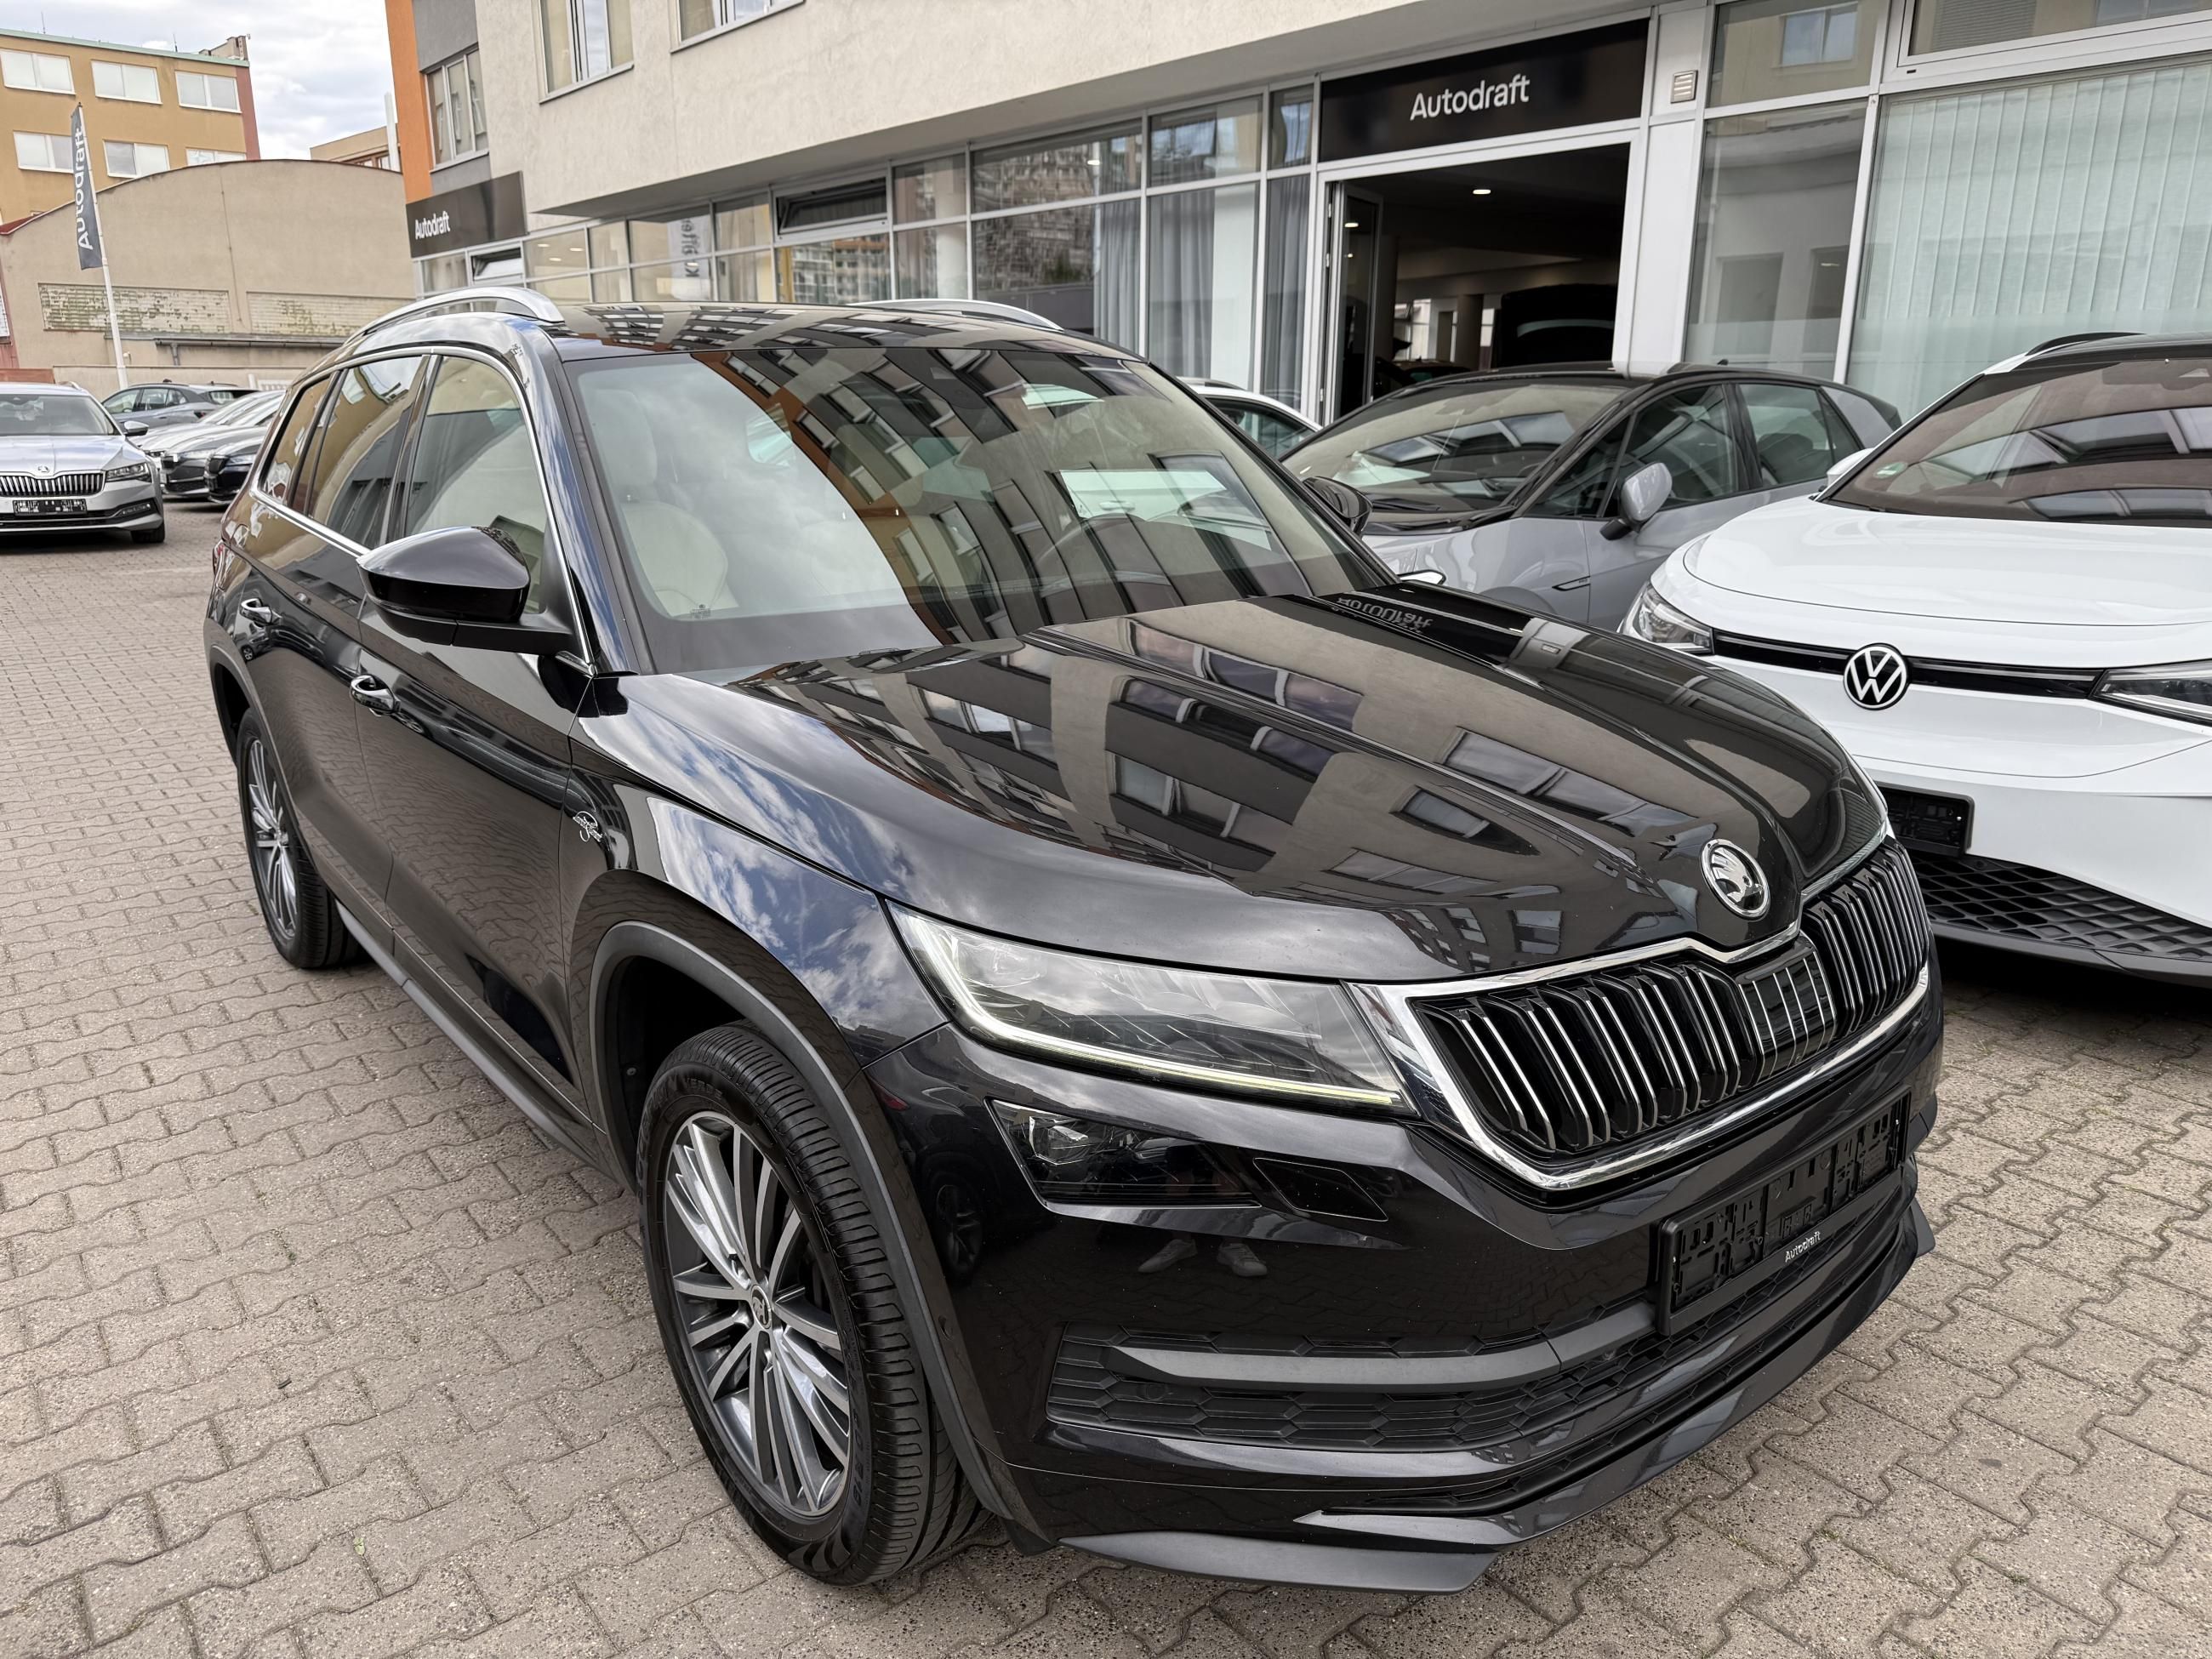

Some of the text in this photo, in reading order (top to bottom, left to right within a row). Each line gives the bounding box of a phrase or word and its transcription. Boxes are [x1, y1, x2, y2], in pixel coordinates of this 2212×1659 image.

[1409, 73, 1531, 121] Autodraft
[74, 125, 94, 251] Autodraft
[414, 210, 451, 240] Autodraft
[1847, 647, 1904, 704] VW
[1785, 1230, 1821, 1263] Autodraft
